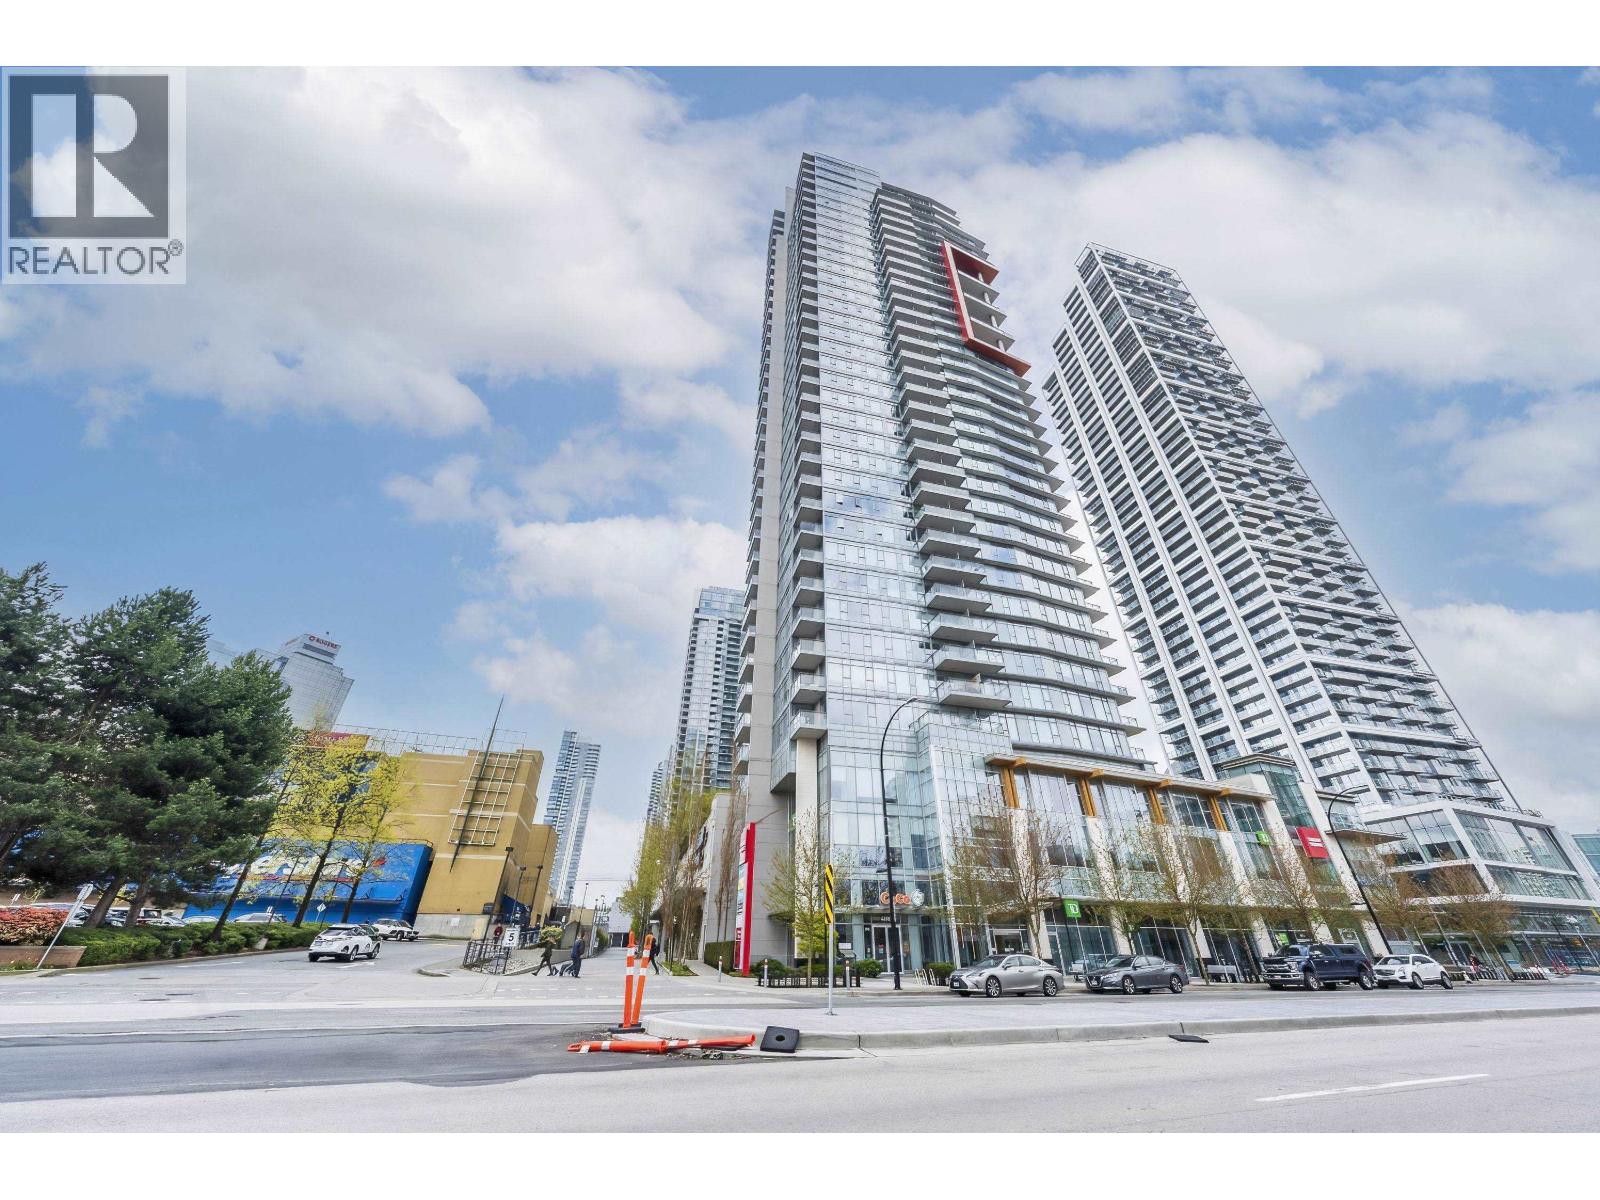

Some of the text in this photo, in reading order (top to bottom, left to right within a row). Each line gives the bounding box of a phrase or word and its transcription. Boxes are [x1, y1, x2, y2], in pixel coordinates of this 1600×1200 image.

[880, 891, 911, 905] CCo
[1067, 903, 1080, 914] TD
[508, 932, 515, 942] 5
